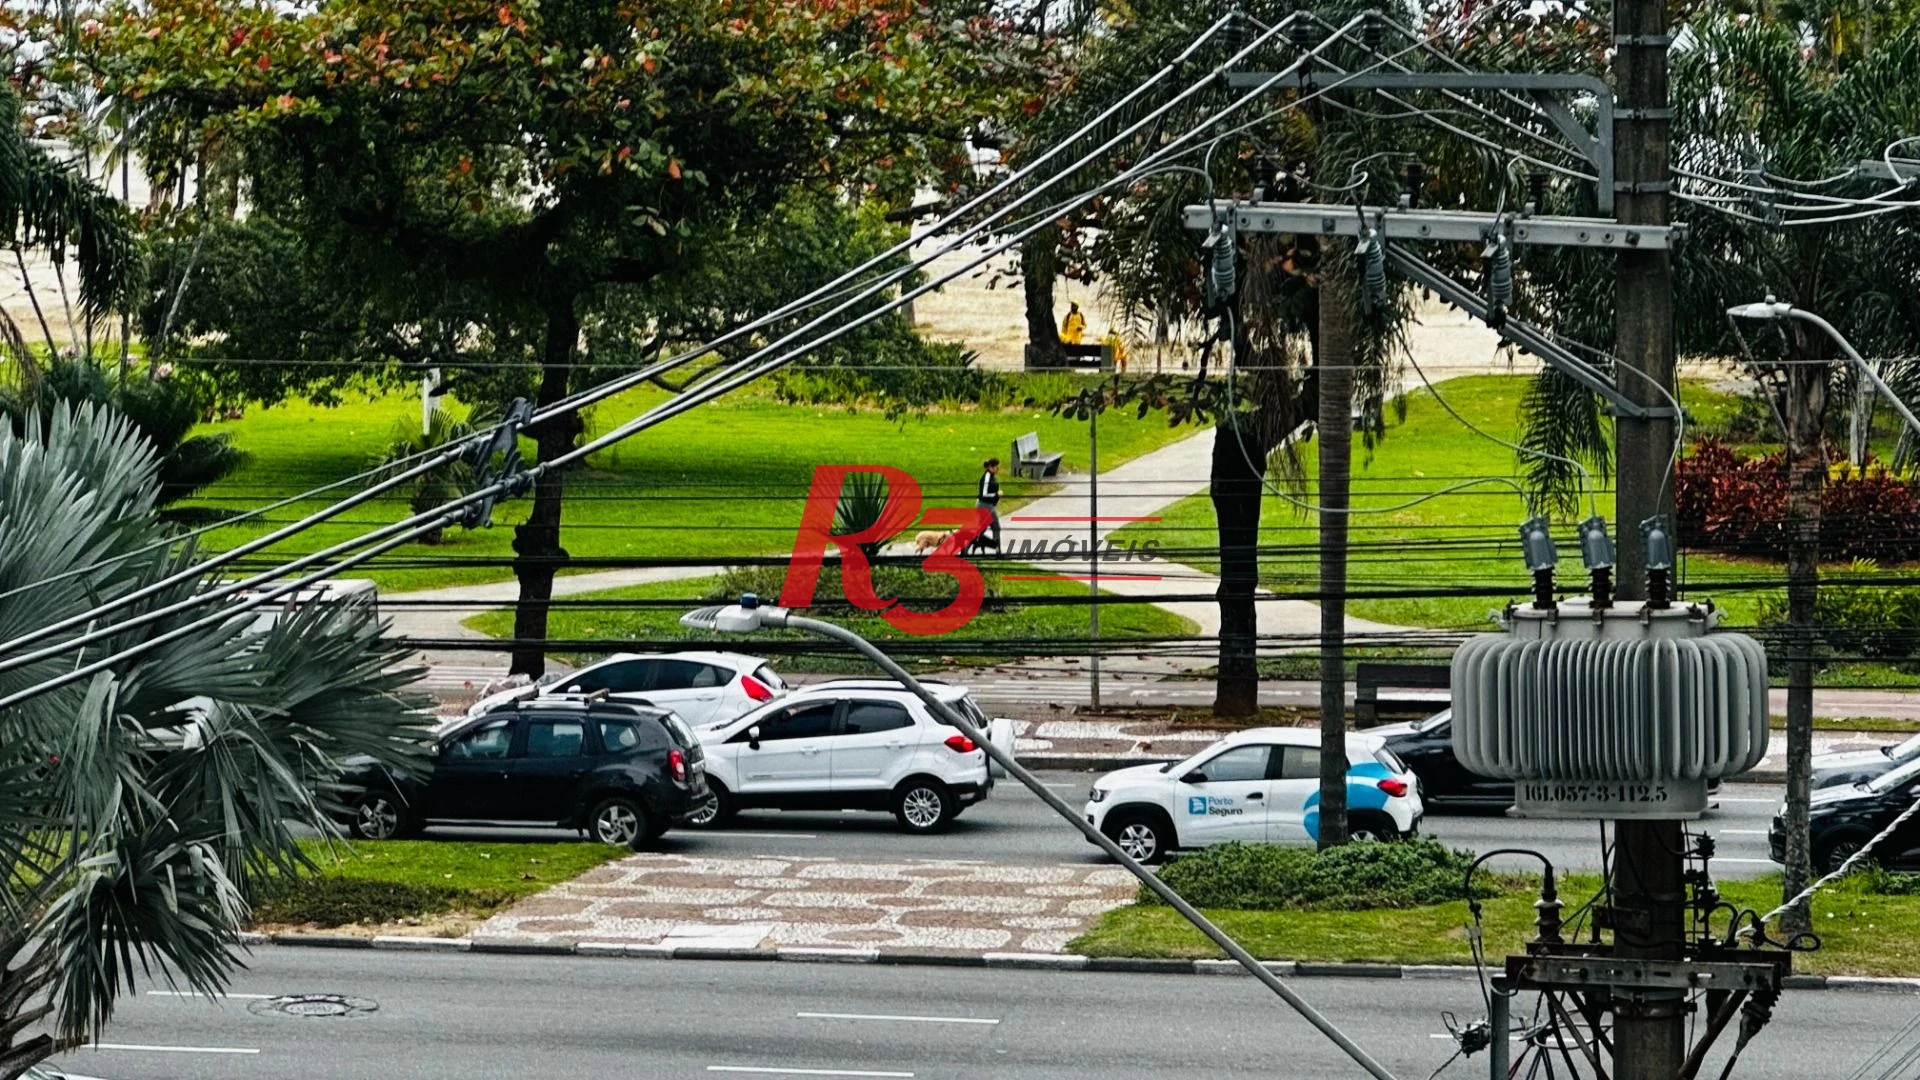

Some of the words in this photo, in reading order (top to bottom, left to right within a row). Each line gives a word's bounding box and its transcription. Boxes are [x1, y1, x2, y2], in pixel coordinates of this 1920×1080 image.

[1525, 784, 1668, 802] 161.057-3-112.5
[1208, 796, 1234, 806] Porto
[1208, 806, 1243, 817] Seguro
